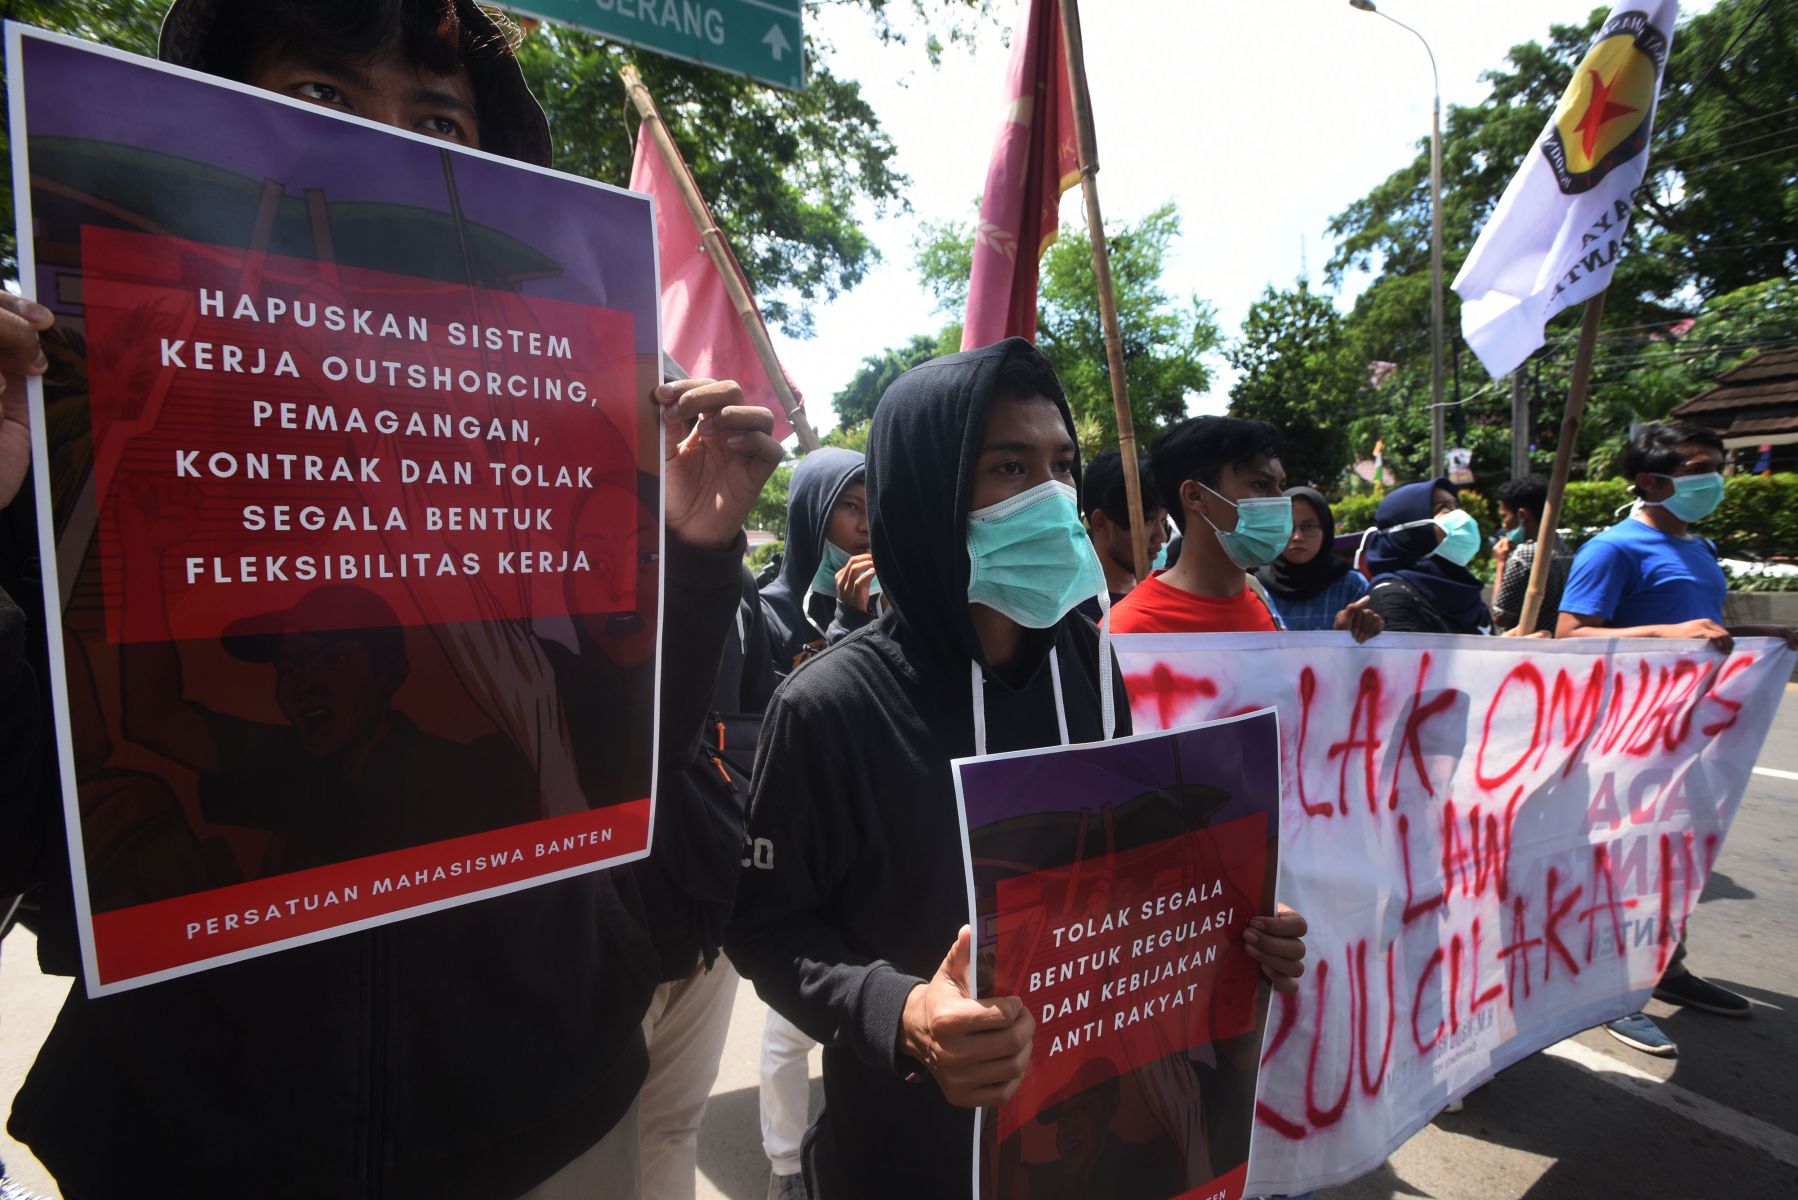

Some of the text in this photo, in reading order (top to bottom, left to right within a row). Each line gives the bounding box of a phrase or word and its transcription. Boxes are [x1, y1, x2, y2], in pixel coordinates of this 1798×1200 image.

[199, 287, 572, 359] HAPUSKAN SISTEM
[160, 338, 598, 408] KERJA OUTSHORCING,
[253, 401, 540, 445] PEMAGANGAN,
[176, 449, 593, 488] KONTRAK DAN TOLAK
[243, 505, 553, 531] SEGALA BENTUK
[186, 550, 591, 584] FLEKSIBILITAS KERJA
[1123, 652, 1754, 817] TLAK OMNIBUS
[186, 827, 613, 940] PERSATUAN MAHASISWA BANTEN
[1398, 784, 1524, 925] LAW
[1052, 879, 1223, 948] TOLAK SEGALA
[1029, 907, 1234, 993] BENTUK REGULASI
[1041, 945, 1217, 1024] DAN KEBIJAKAN
[1049, 983, 1198, 1056] ANTI RAKYAT
